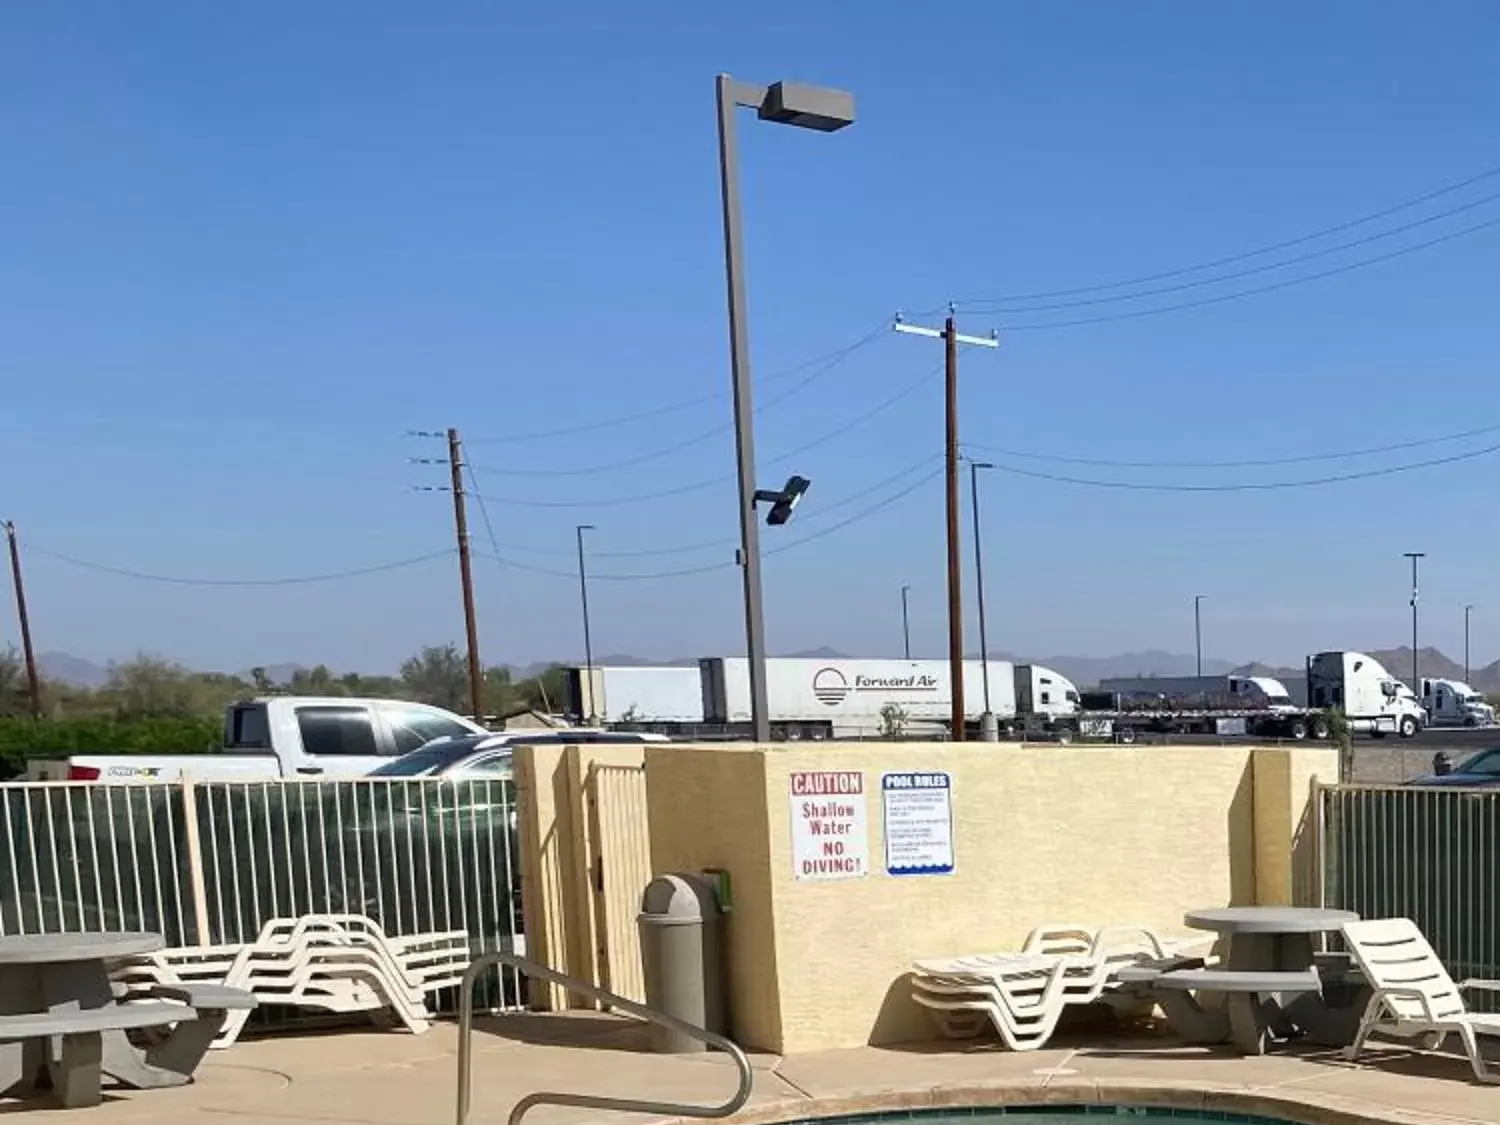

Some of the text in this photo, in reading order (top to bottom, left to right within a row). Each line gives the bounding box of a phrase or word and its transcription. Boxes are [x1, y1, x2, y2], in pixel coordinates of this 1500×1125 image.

[855, 675, 937, 687] Forward Air
[793, 774, 860, 793] CAUTION
[886, 775, 947, 787] POOL RULES
[802, 801, 855, 818] Shallow
[810, 820, 852, 835] Water
[823, 841, 845, 856] NO
[802, 858, 861, 874] DIVING!
